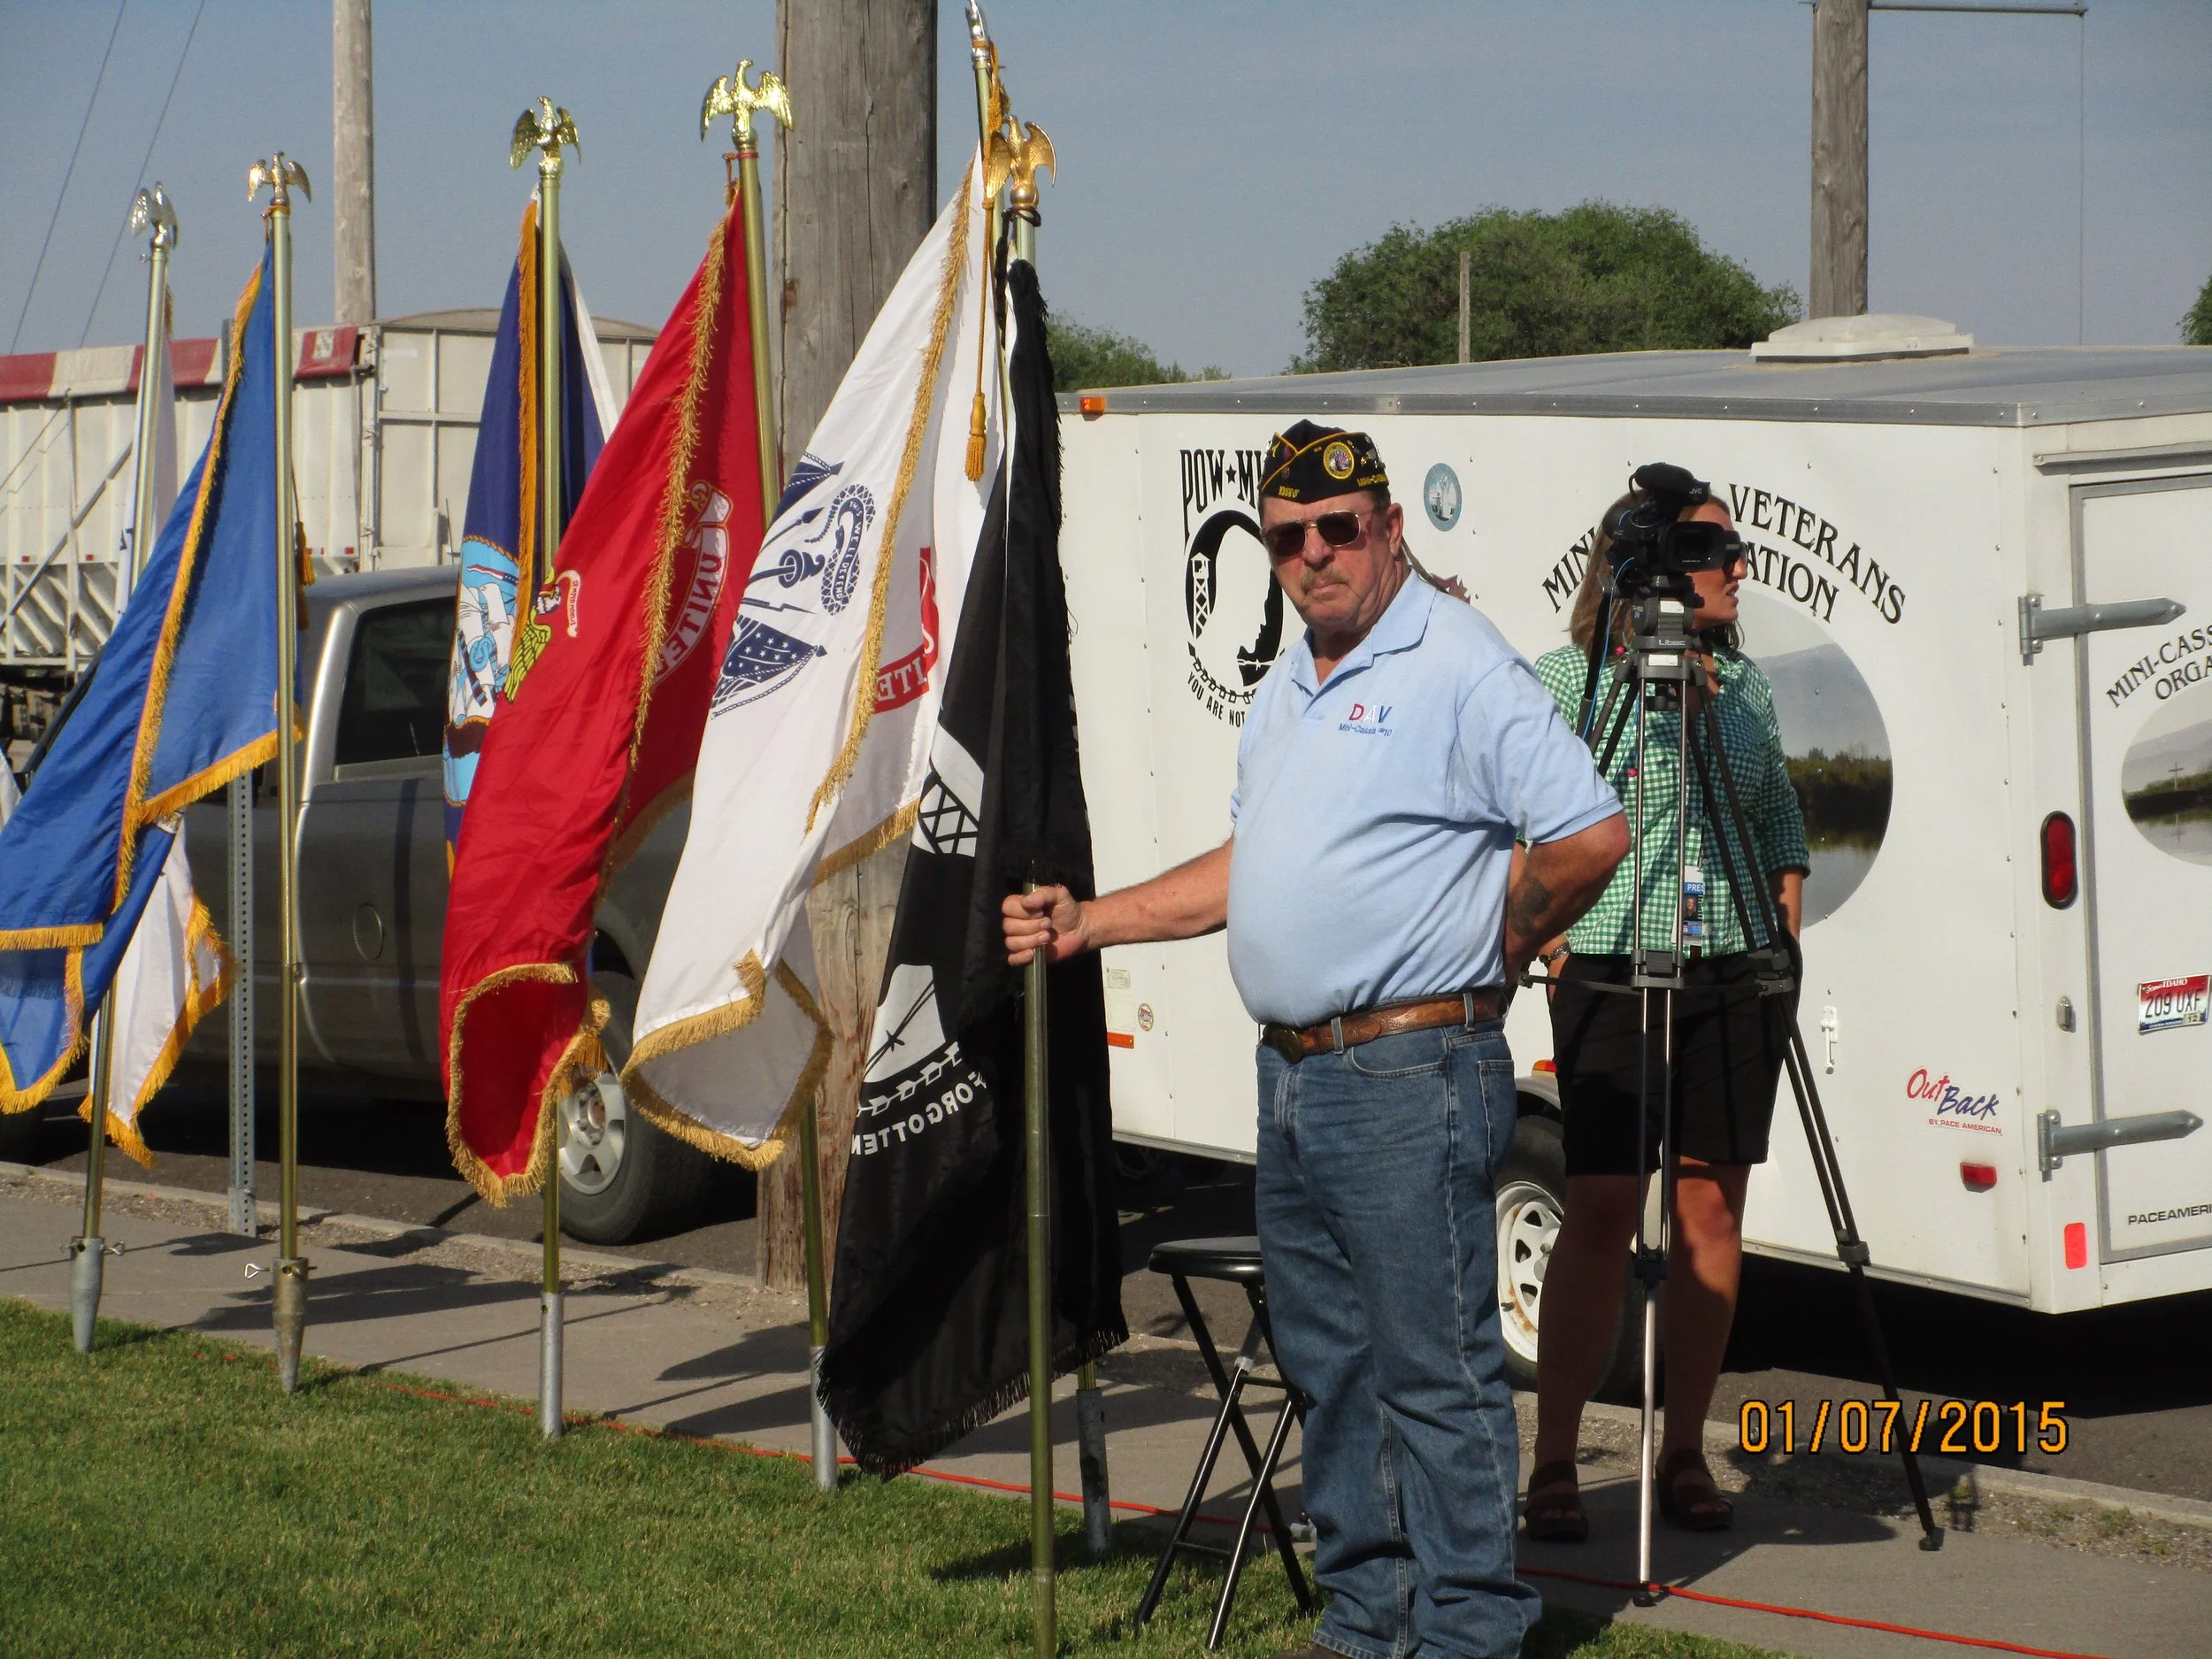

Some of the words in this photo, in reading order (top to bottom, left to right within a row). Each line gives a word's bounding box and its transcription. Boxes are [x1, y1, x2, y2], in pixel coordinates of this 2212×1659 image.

[849, 501, 863, 517] THIS
[1179, 449, 1225, 556] POW
[1729, 483, 1906, 625] VETERANS
[835, 562, 850, 599] DEFEND
[1187, 672, 1204, 700] YOU
[1206, 695, 1224, 720] ARE
[1229, 709, 1246, 728] NOT
[1348, 703, 1393, 723] DAV
[2145, 993, 2172, 1018] 209
[2177, 988, 2203, 1012] UXF
[1907, 1068, 1950, 1102] Out
[1937, 1086, 2000, 1121] Back
[1941, 1119, 1960, 1128] PACE
[1962, 1122, 2001, 1134] AMERICAN
